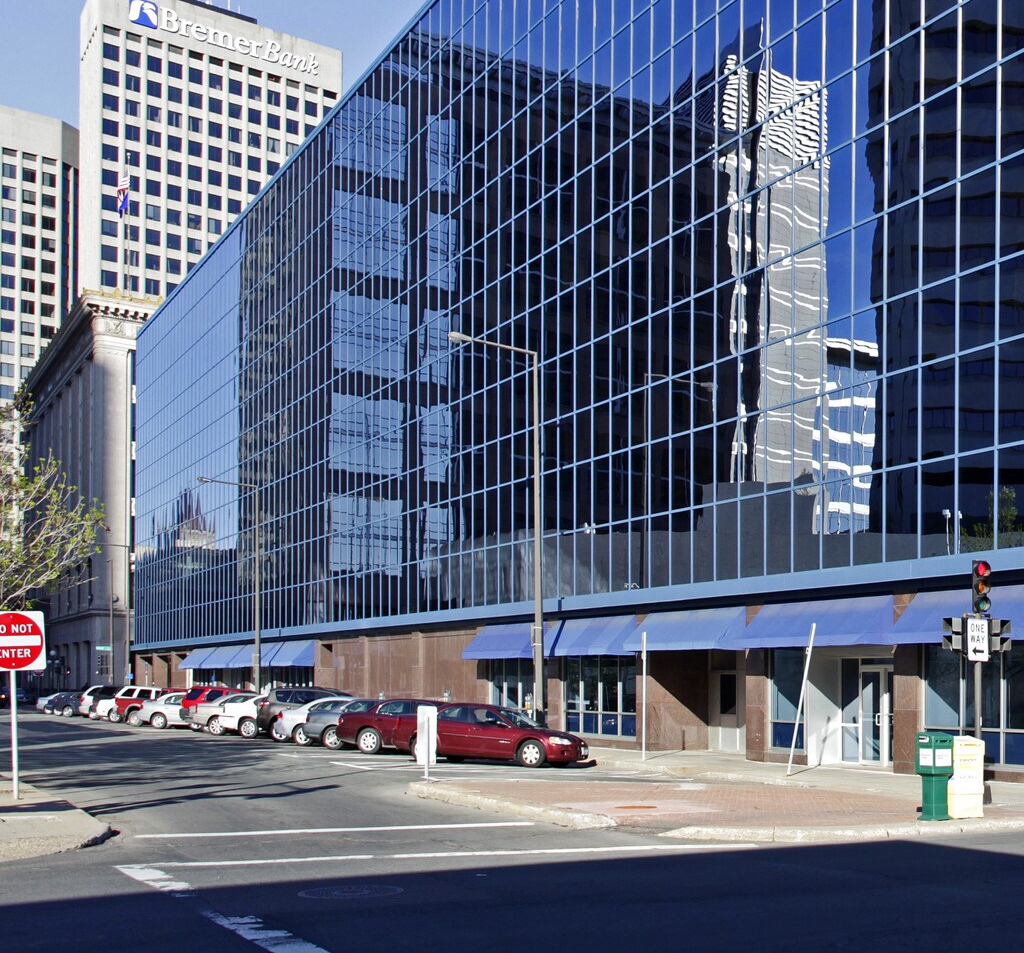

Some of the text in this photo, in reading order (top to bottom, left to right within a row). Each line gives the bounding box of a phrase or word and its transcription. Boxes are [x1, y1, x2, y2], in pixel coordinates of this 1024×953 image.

[0, 623, 33, 634] O NOT
[970, 623, 985, 634] ONE
[970, 635, 985, 644] WAY
[0, 648, 32, 659] NTER
